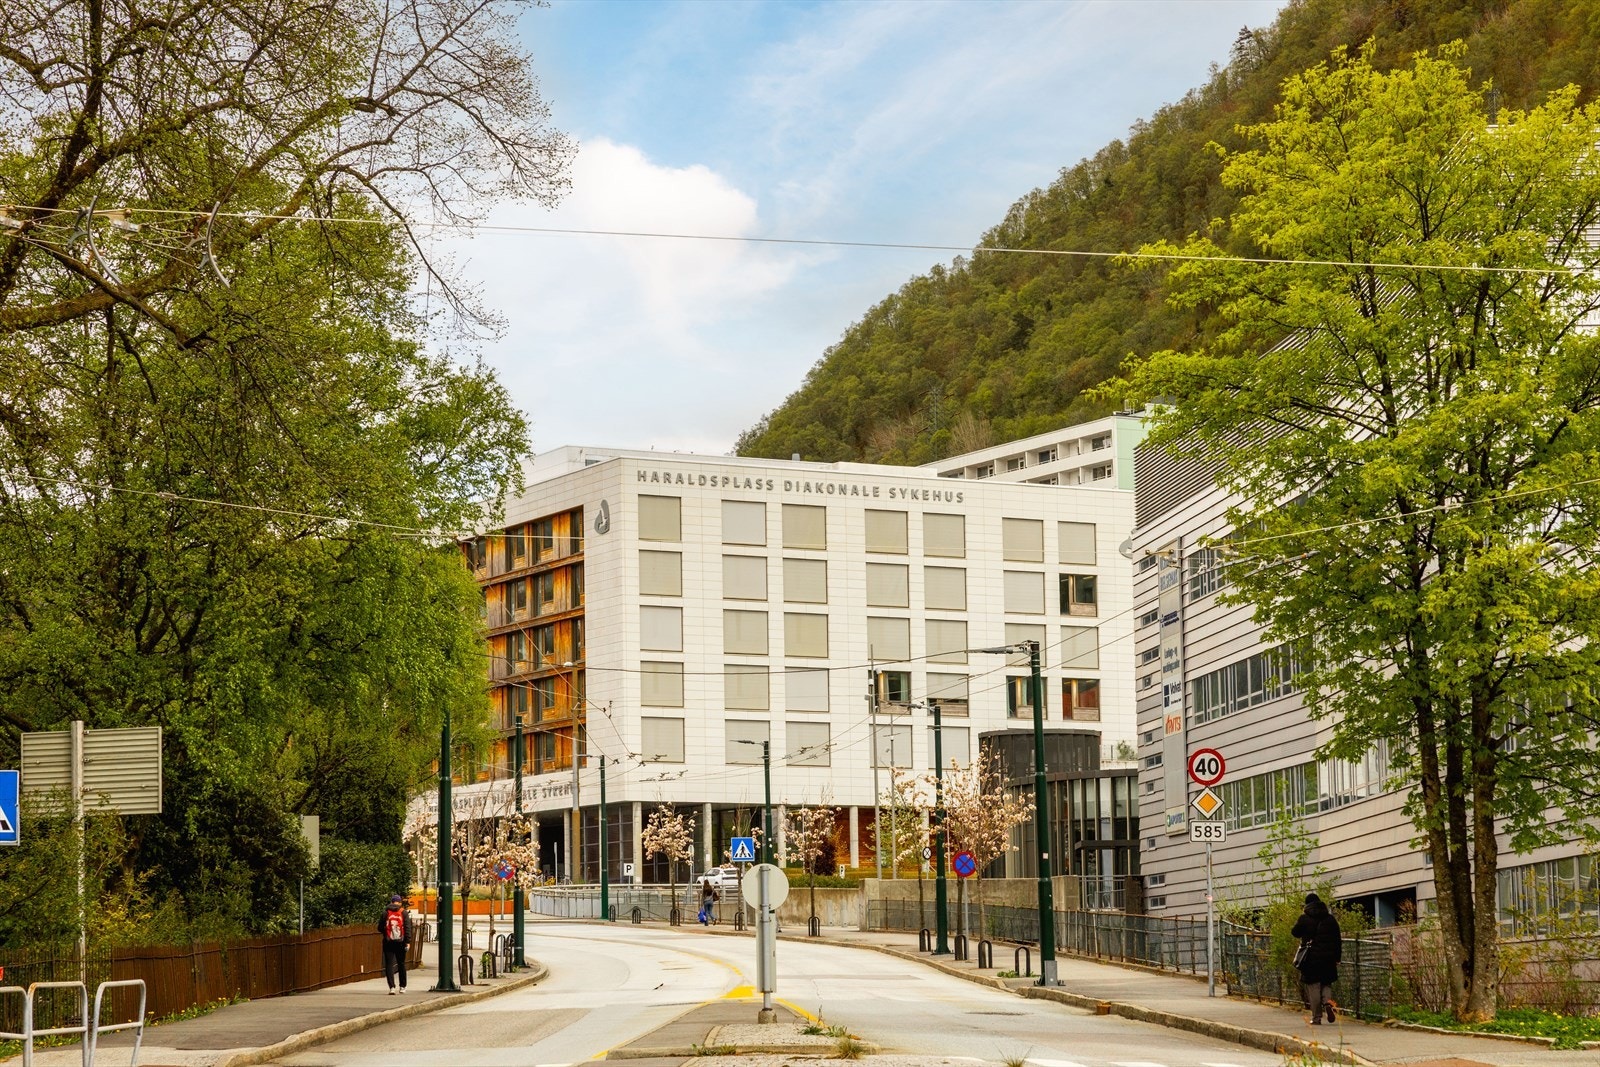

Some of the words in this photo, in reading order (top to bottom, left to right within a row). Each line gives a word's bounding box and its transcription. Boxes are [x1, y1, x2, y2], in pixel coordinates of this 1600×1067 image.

[637, 470, 774, 491] HARALDSPLASS
[783, 479, 879, 498] DIAKONALE
[888, 487, 964, 503] SYKEHUS
[1195, 758, 1220, 776] 40
[1194, 826, 1222, 838] 585
[626, 864, 632, 874] P
